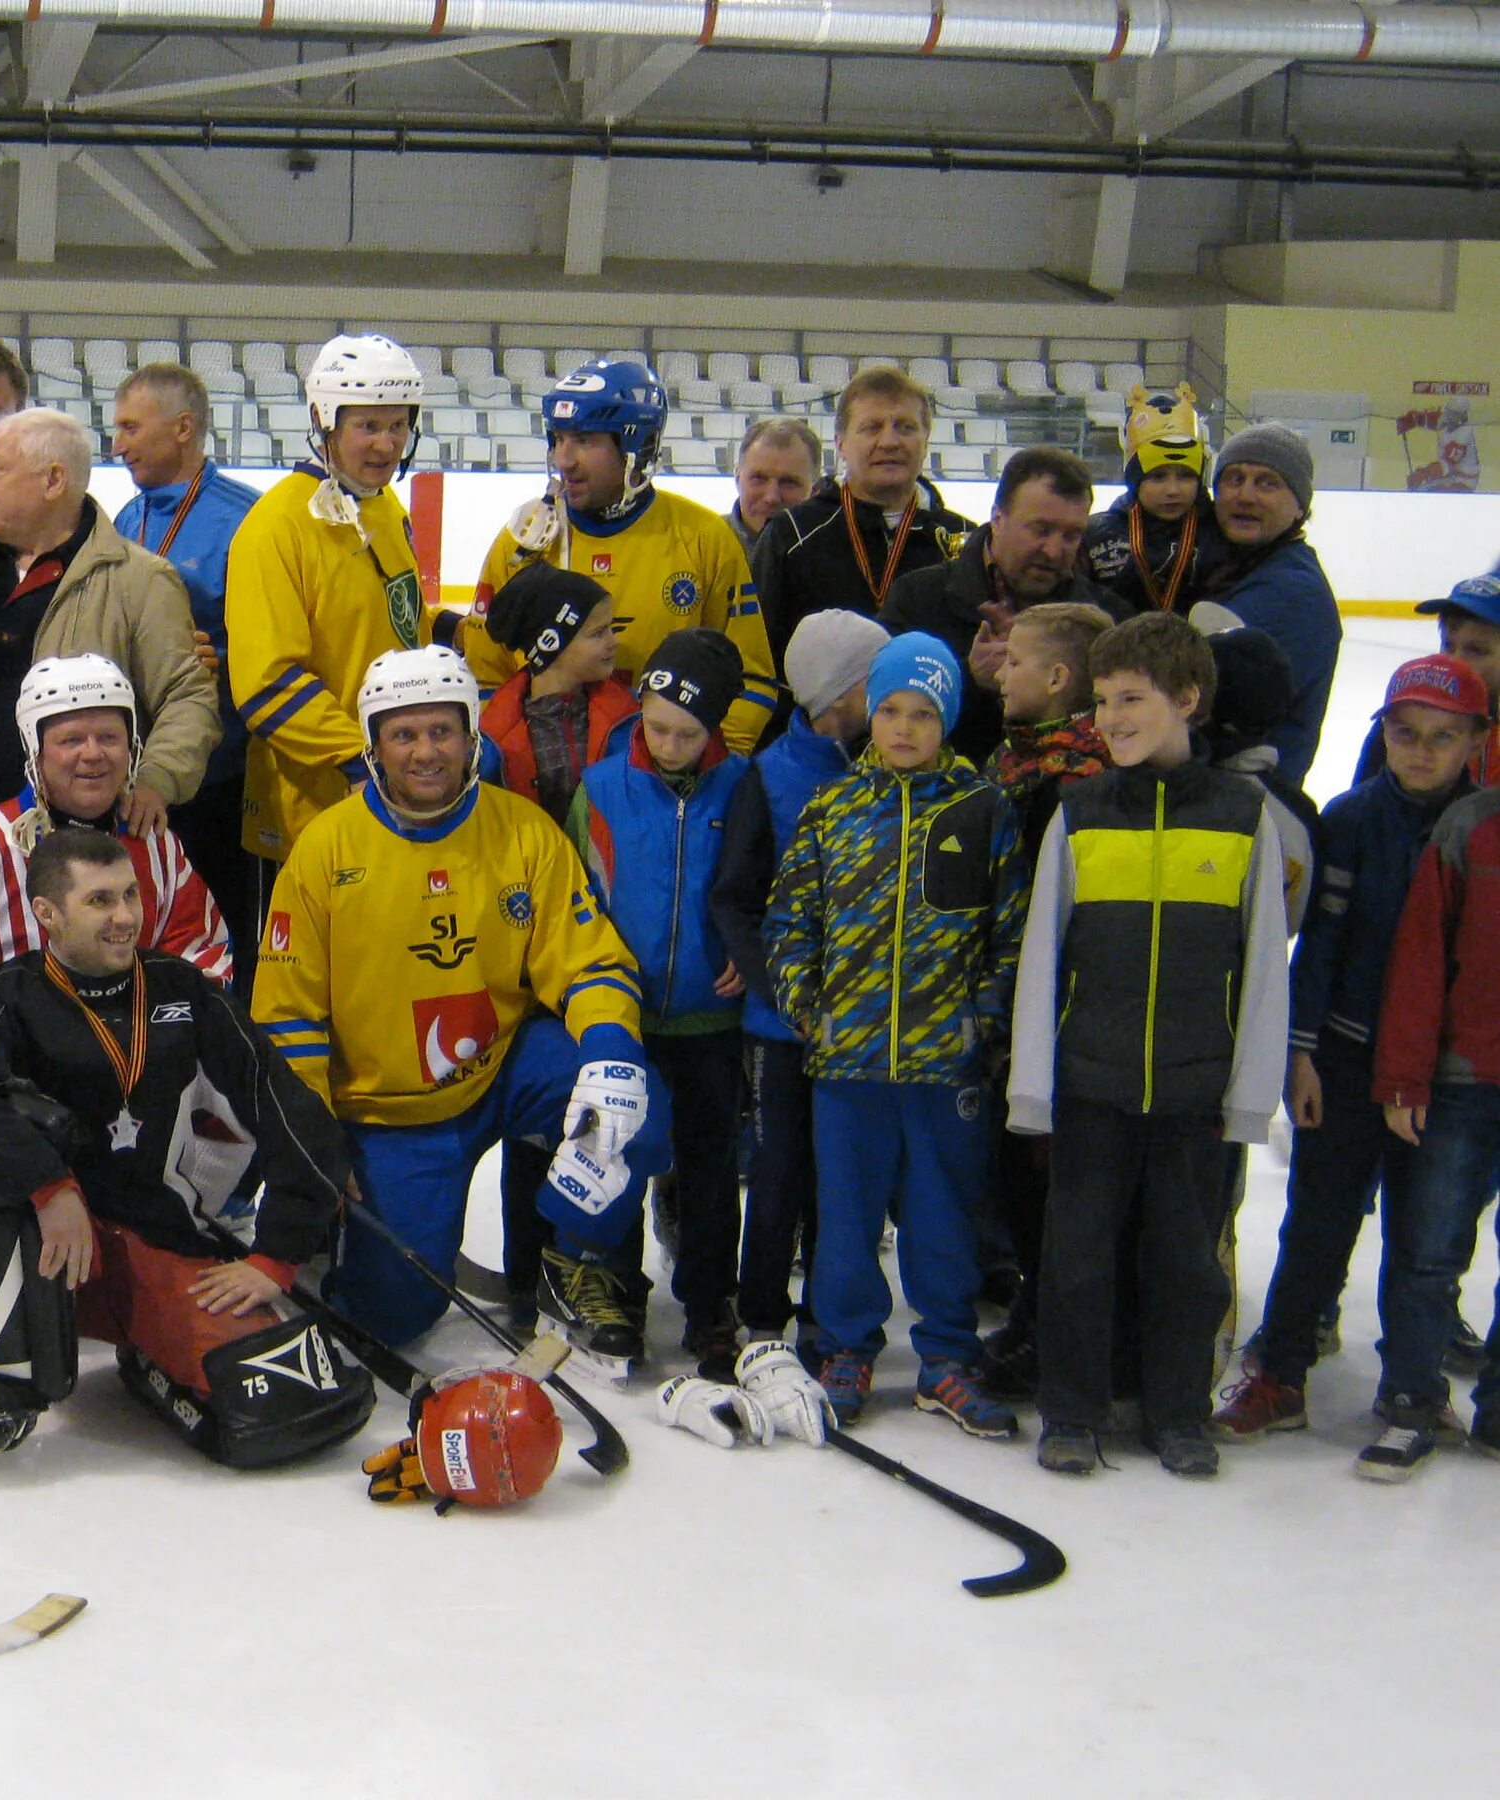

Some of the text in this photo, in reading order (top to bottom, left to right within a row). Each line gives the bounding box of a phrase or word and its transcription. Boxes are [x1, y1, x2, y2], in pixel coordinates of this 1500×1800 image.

[623, 424, 637, 436] 77
[69, 682, 104, 692] Reebok
[393, 678, 430, 690] Reebok
[679, 690, 693, 705] 01
[430, 914, 458, 940] SJ
[604, 1094, 638, 1110] team
[574, 1150, 606, 1180] team
[241, 1374, 270, 1399] 75
